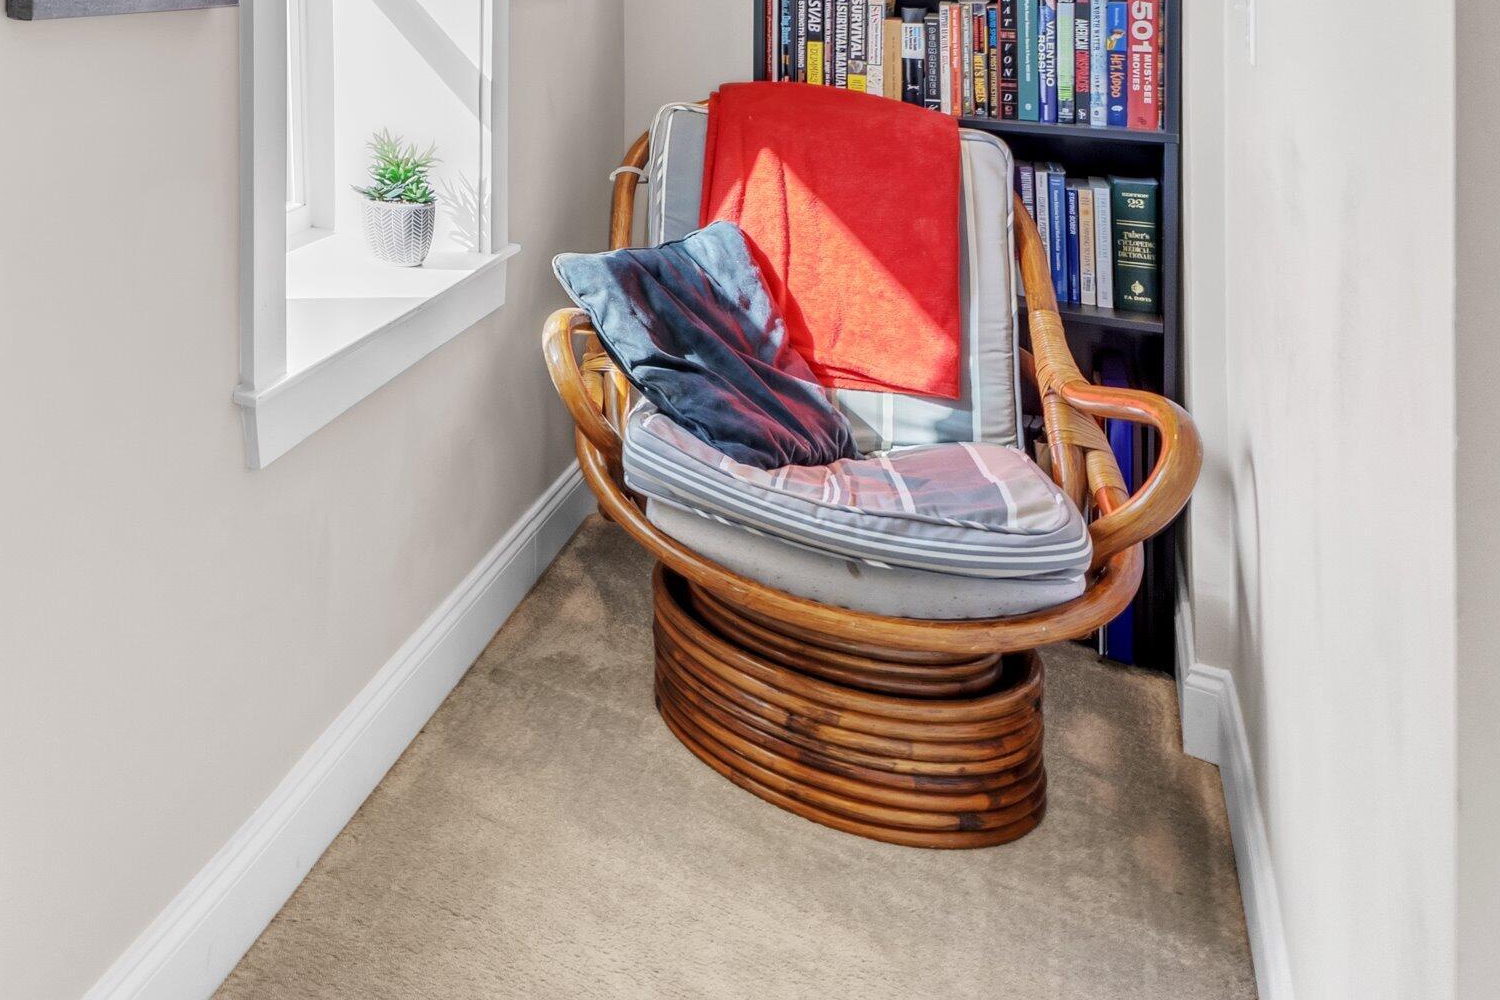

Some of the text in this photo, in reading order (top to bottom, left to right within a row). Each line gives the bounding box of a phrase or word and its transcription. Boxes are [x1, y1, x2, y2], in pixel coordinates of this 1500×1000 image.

[835, 5, 847, 51] SURVIVAL
[1075, 18, 1088, 50] AMERICAN
[1130, 0, 1153, 53] 501
[1127, 199, 1145, 209] 22
